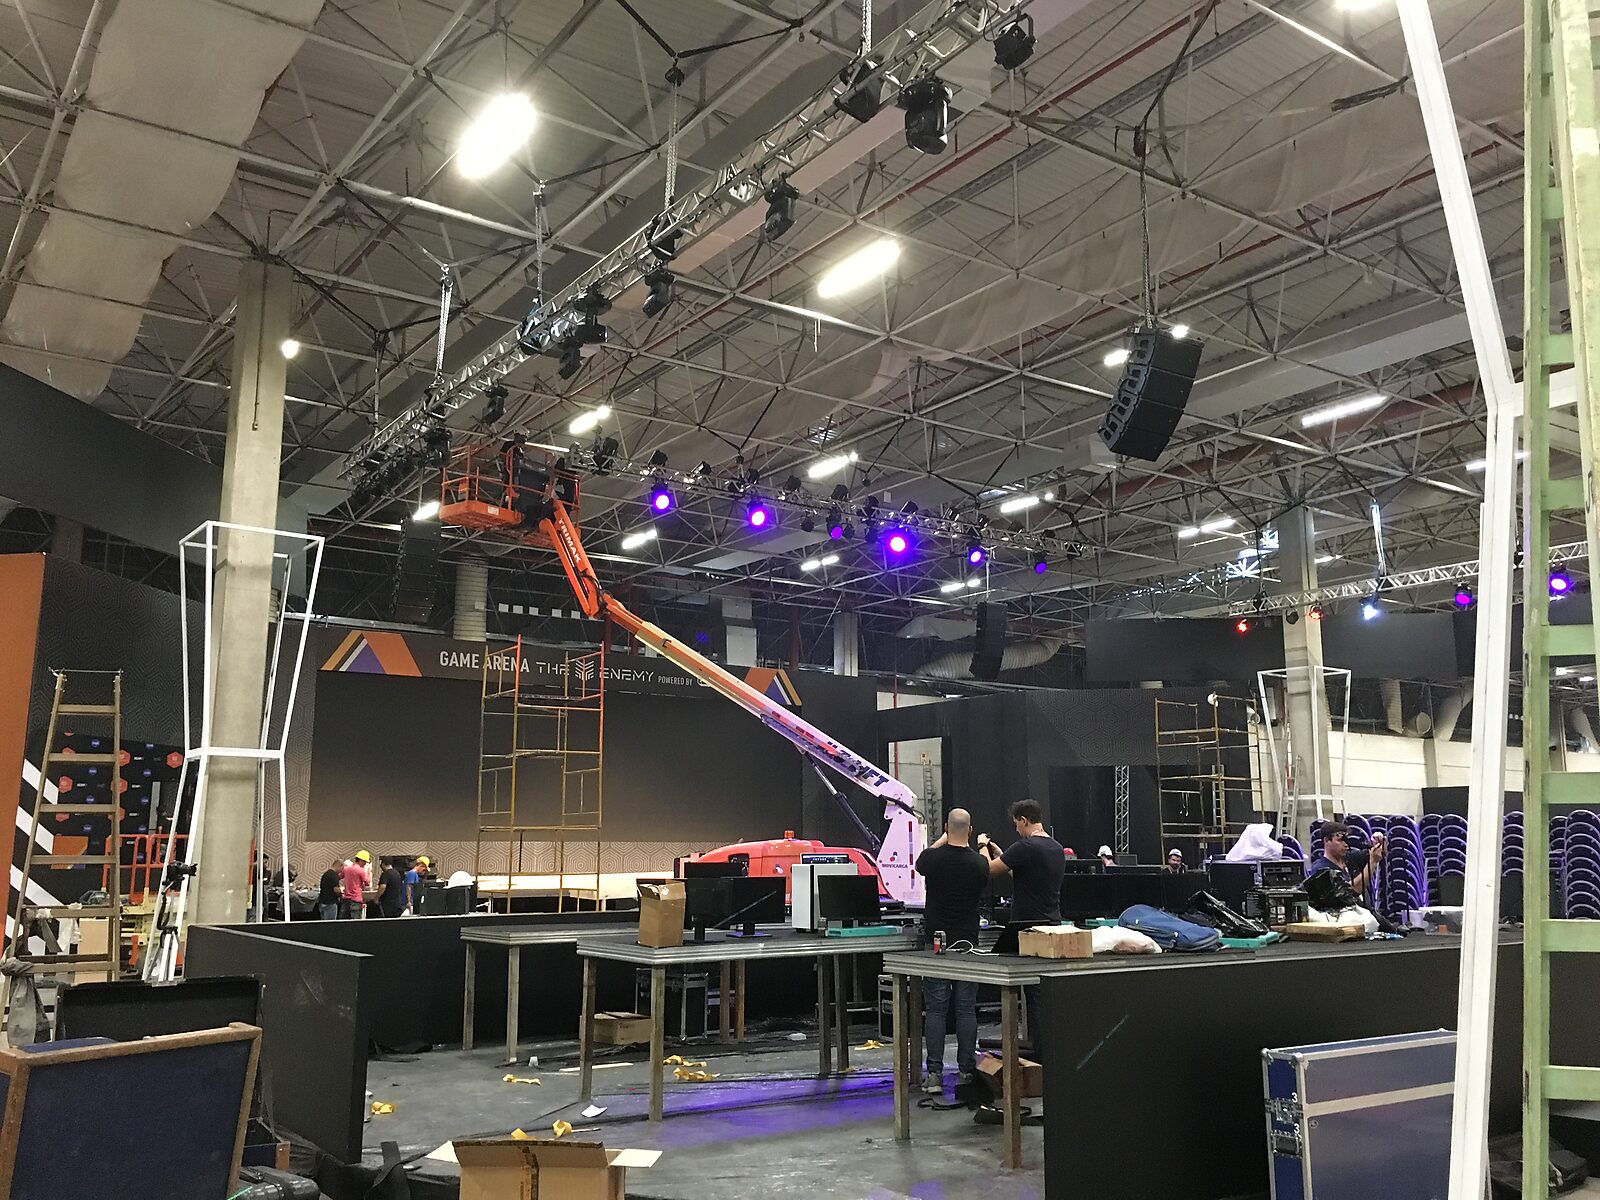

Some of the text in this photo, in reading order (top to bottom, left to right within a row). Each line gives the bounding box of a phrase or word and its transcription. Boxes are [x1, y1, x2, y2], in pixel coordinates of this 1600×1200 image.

[558, 517, 581, 563] TRIMAK
[439, 650, 480, 669] GAME
[482, 655, 530, 673] ARENA
[536, 661, 570, 675] THE
[599, 667, 654, 682] ENEMY
[657, 675, 685, 686] POWERED
[685, 677, 693, 686] BY
[1291, 1092, 1298, 1103] 3
[1293, 1123, 1300, 1134] 3
